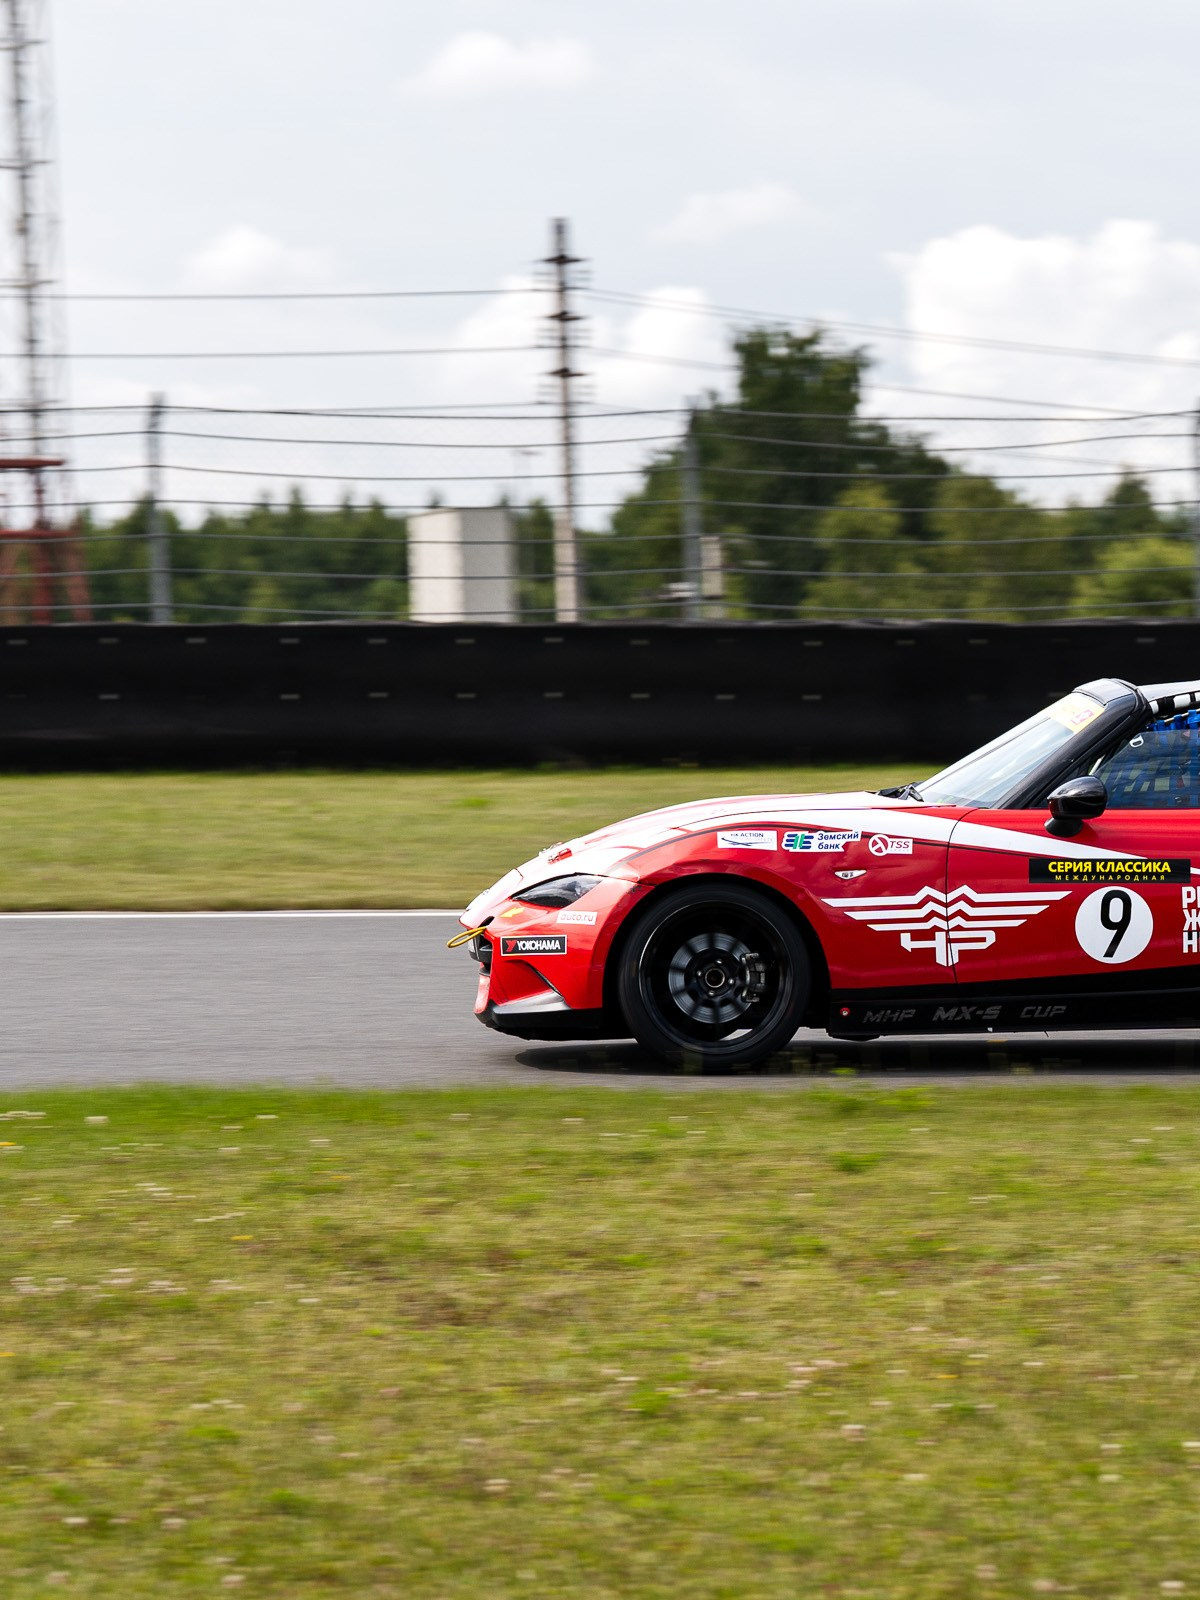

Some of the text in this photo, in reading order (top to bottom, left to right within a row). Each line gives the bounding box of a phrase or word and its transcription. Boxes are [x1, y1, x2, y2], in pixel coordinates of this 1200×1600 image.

[817, 832, 859, 841] Земский
[817, 841, 841, 850] банк
[889, 840, 910, 849] TSS
[1048, 861, 1172, 873] СЕРИЯ КЛАССИКА
[560, 912, 594, 922] auto.ru
[1100, 889, 1132, 958] 9
[517, 939, 561, 951] YOKOHAMA
[932, 1005, 1002, 1022] MX-5
[1019, 1005, 1067, 1018] CUP
